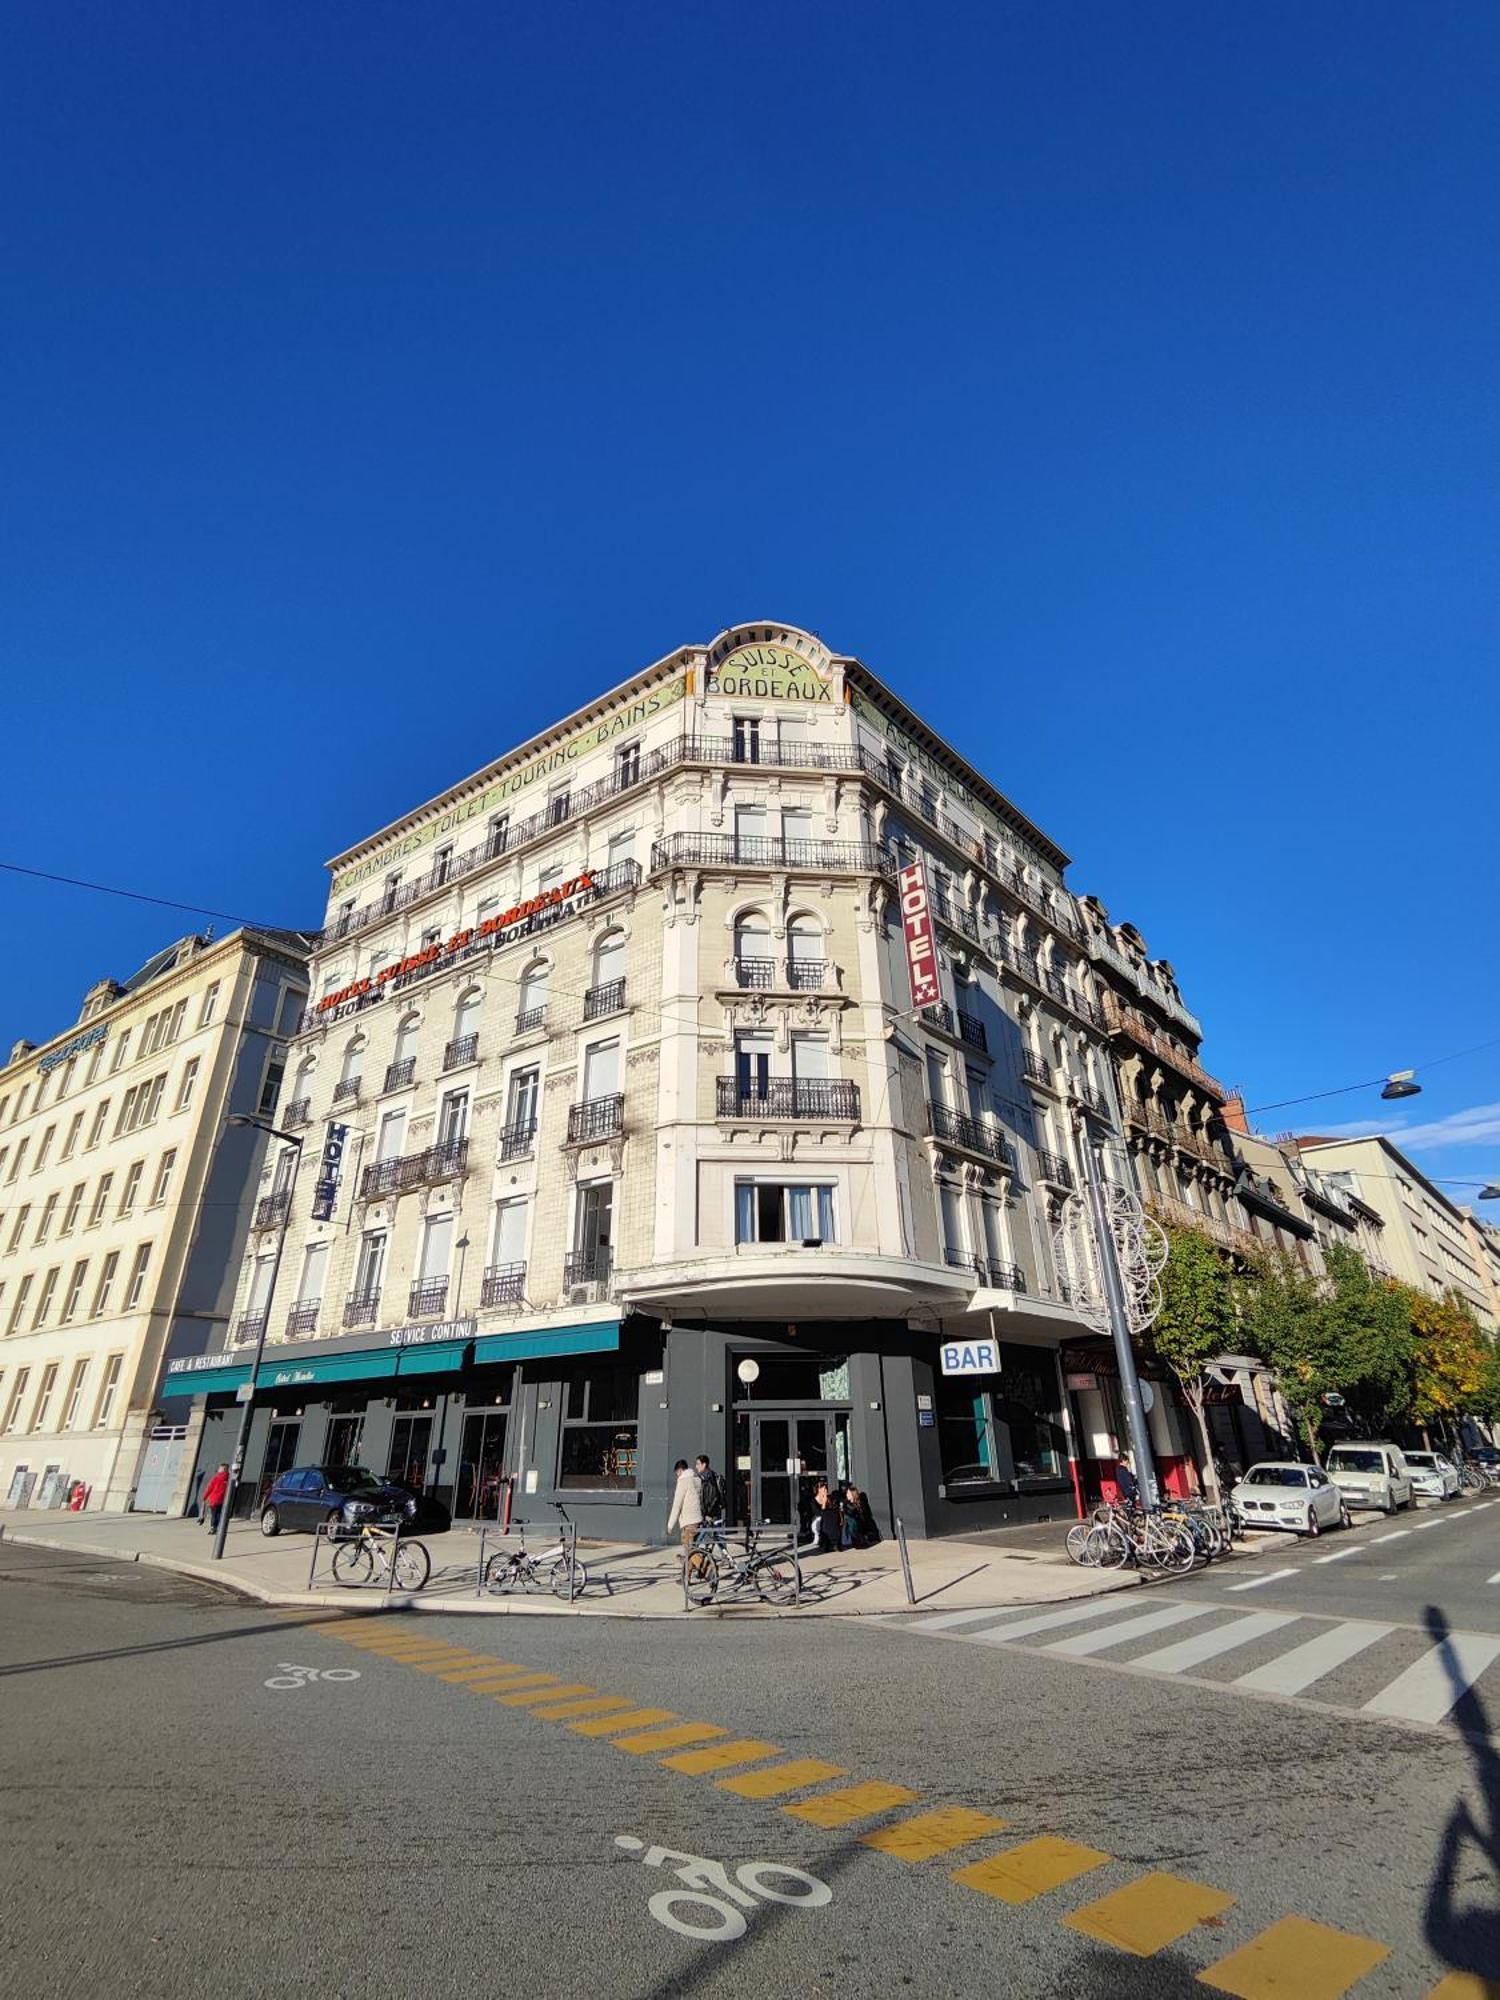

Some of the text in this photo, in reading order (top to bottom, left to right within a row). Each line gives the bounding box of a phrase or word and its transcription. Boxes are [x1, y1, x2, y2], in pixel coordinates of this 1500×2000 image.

[729, 648, 810, 677] SUISSE
[707, 676, 832, 701] BORDEAUX
[344, 831, 423, 887] CHAMBRES
[596, 695, 661, 744] BAINS
[900, 865, 934, 987] HOTEL
[318, 977, 372, 1014] HOTEL
[376, 942, 444, 986] SUISSE
[447, 928, 474, 955] ET
[478, 869, 597, 941] BORDEAUX
[390, 1321, 472, 1345] SERVICE CONTINU
[195, 1353, 236, 1370] RESTAURANT
[944, 1345, 993, 1370] BAR
